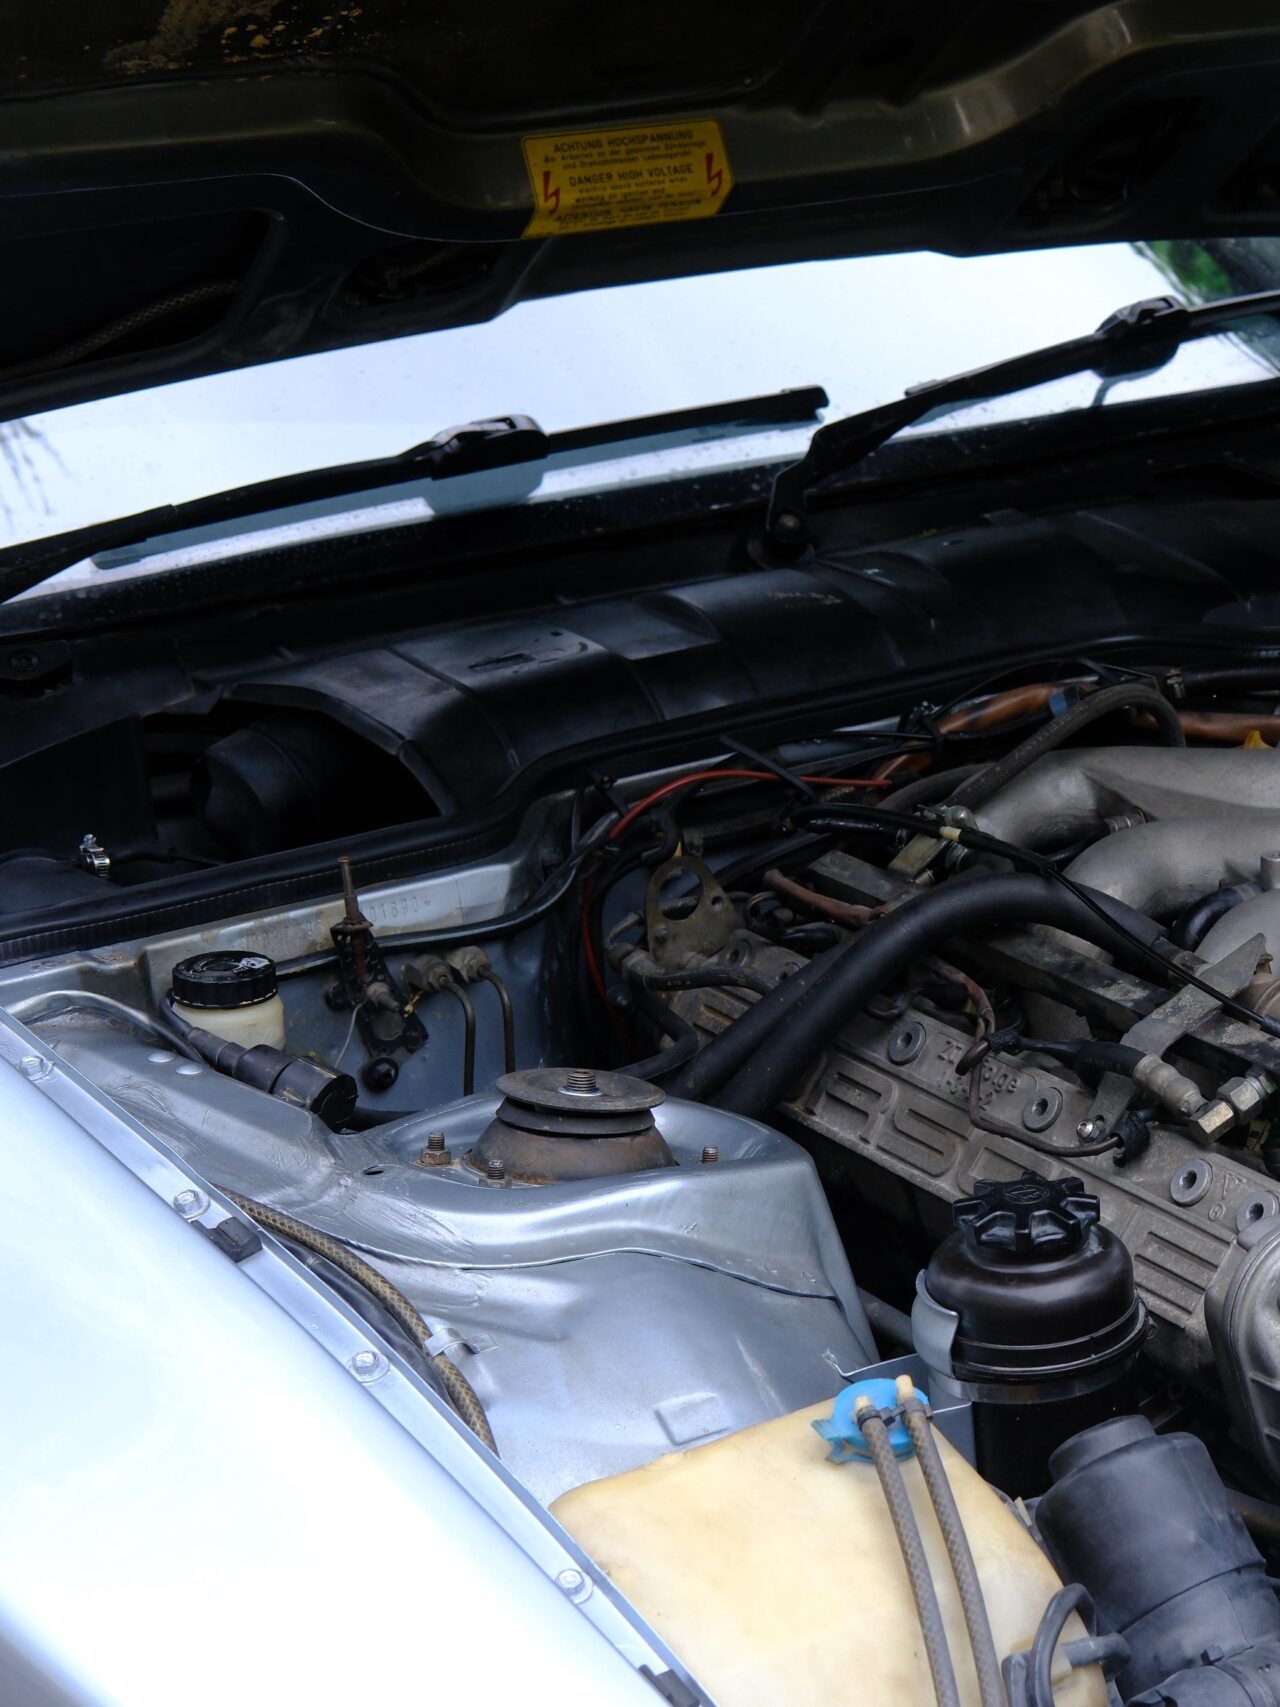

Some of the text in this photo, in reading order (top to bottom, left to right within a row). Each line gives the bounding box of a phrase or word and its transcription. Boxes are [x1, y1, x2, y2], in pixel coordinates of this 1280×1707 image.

[554, 130, 693, 152] ACHTUNG HOCHSPANNUNG
[569, 164, 693, 186] DANGER HIGH VOLTAGE
